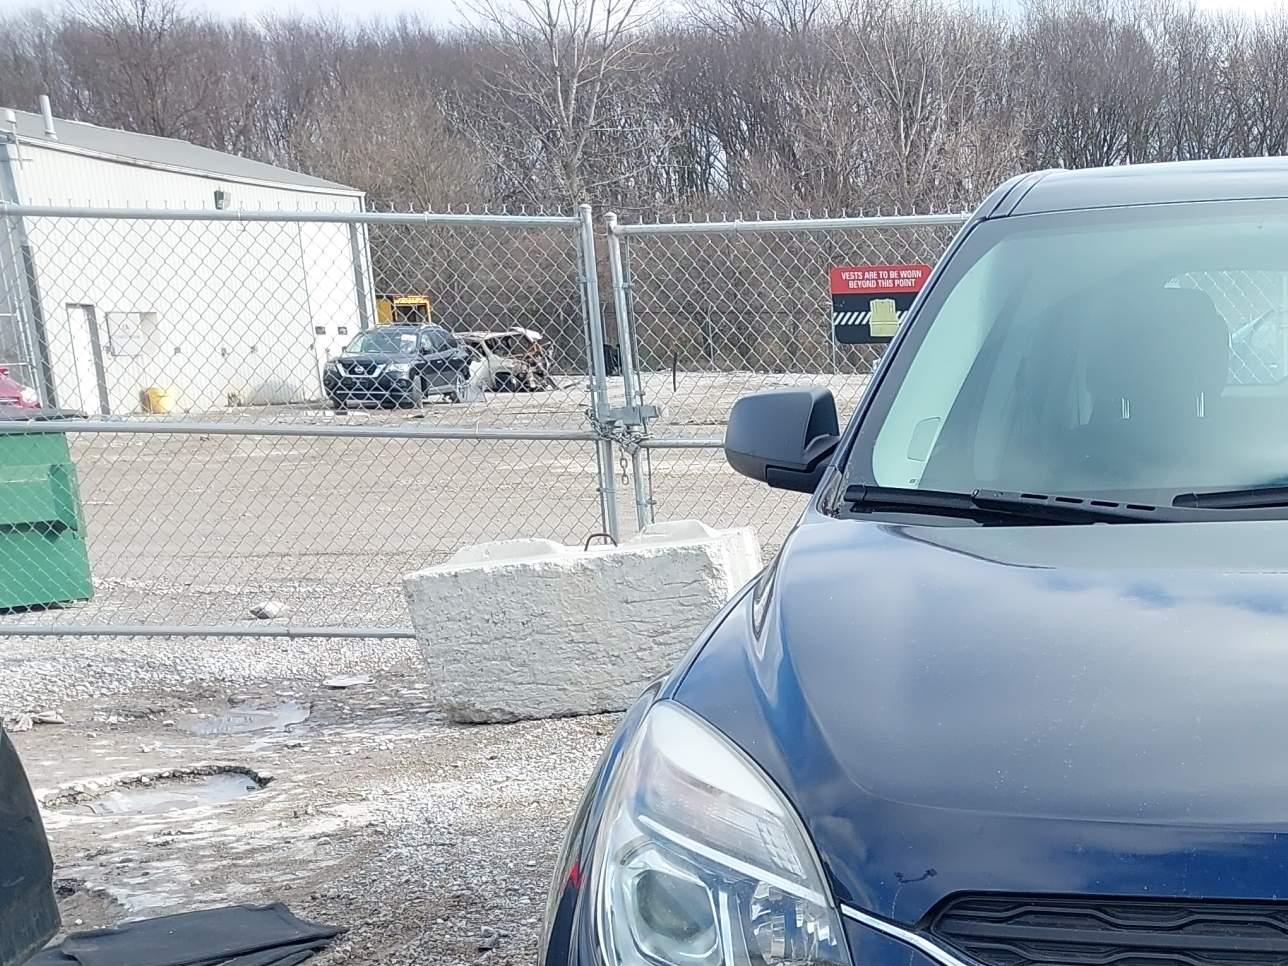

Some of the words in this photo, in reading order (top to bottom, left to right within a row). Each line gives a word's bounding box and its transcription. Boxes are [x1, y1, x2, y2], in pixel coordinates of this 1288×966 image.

[841, 271, 862, 279] VESTS
[864, 271, 877, 279] ARE
[878, 271, 889, 279] TO
[890, 270, 899, 278] BE
[899, 270, 922, 278] WORN
[849, 279, 877, 288] BEYOND
[877, 279, 894, 288] THIS
[894, 278, 916, 287] POINT
